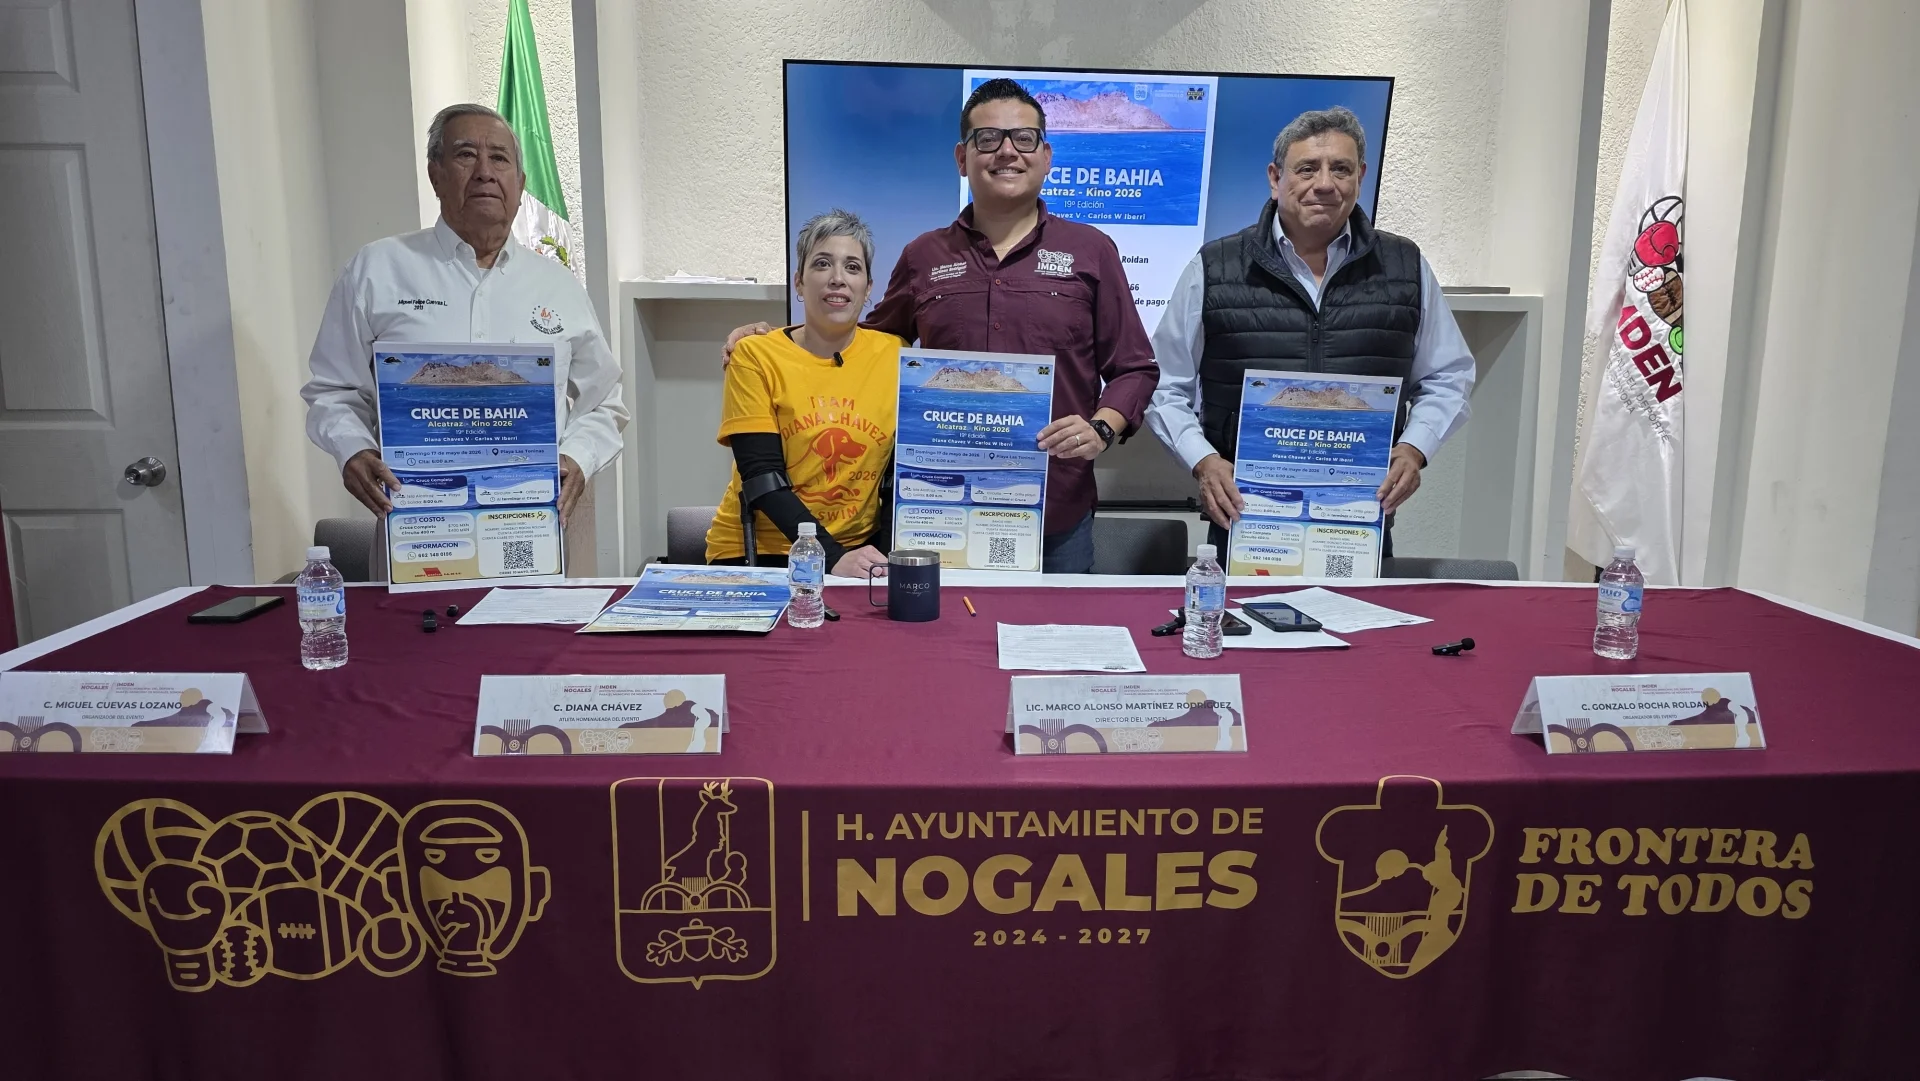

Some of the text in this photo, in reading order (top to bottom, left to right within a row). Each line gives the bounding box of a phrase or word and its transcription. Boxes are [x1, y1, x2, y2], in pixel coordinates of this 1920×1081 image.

[1044, 167, 1163, 186] CE DE BAHIA
[1040, 188, 1141, 197] catraz Kino 2026
[1037, 262, 1072, 273] IMDEN
[808, 396, 854, 411] TEAM
[411, 408, 528, 420] CRUCE DE BAHIA
[923, 411, 1024, 426] CRUCE DE BAHIA
[1636, 393, 1670, 442] DEPORTE
[781, 412, 824, 442] DIANA
[1265, 428, 1366, 443] CRUCE DE BAHIA
[848, 470, 876, 481] 2026
[818, 506, 858, 521] SWIM
[601, 702, 642, 711] CHÁVEZ
[1126, 701, 1174, 710] MARTÍNEZ
[1176, 701, 1231, 709] RODRÍGUEZ
[1592, 702, 1635, 711] GONZALO
[837, 806, 1264, 841] H. AYUNTAMIENTO DE
[1518, 827, 1814, 869] FRONTERA
[836, 850, 1258, 917] NOGALES
[1511, 873, 1814, 920] DE TODOS
[973, 928, 1047, 946] 2024
[1078, 928, 1152, 944] 2027
